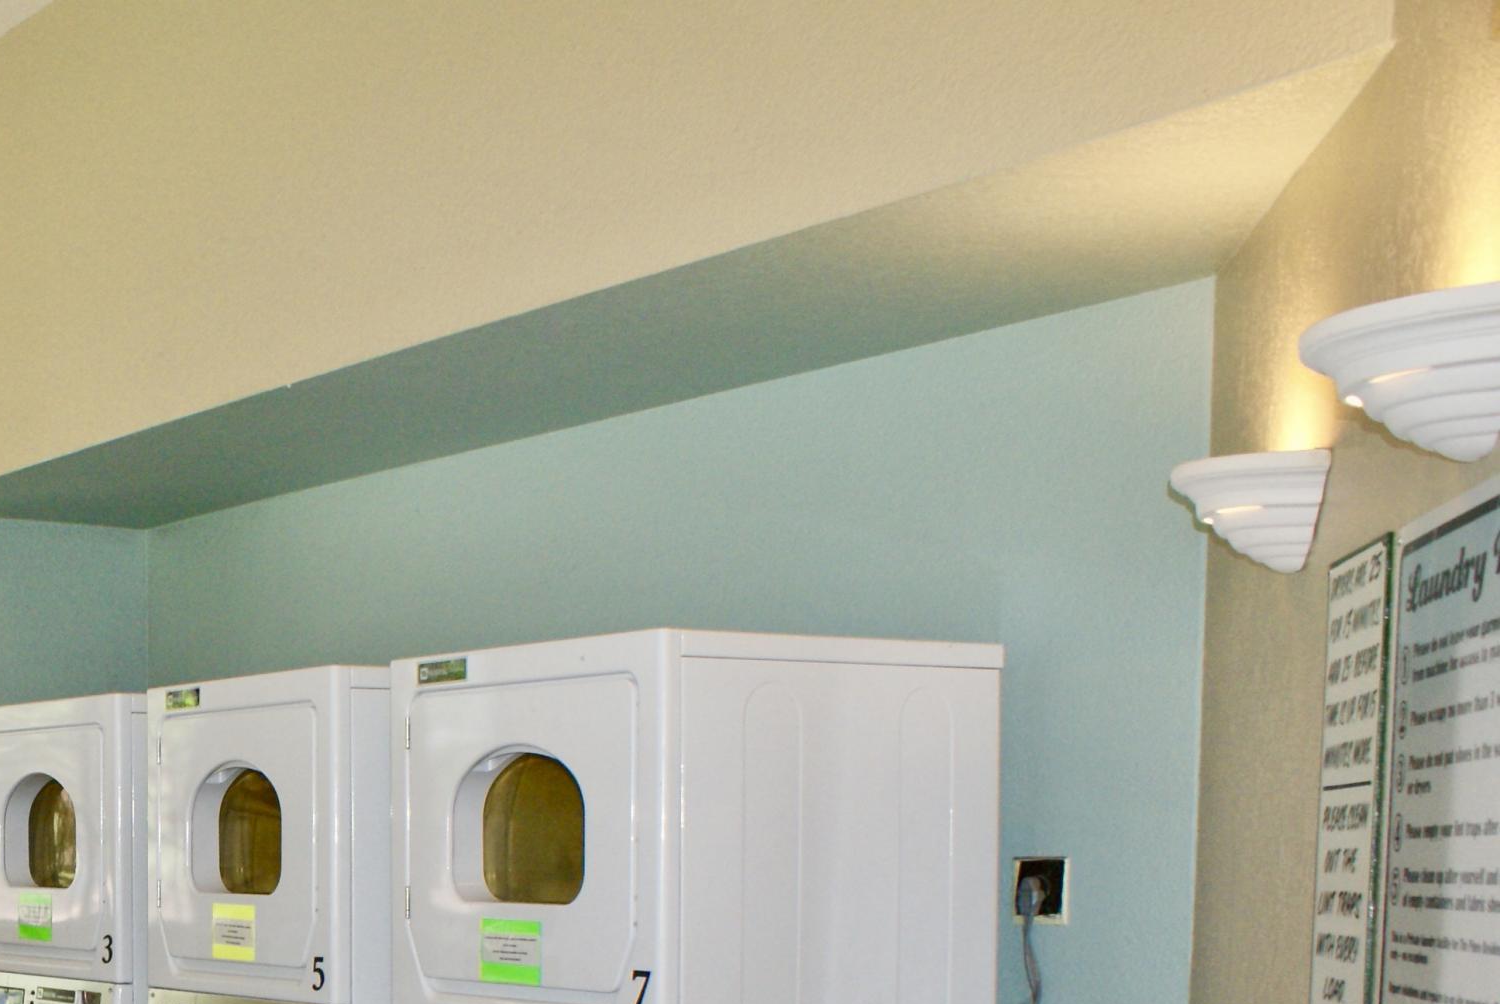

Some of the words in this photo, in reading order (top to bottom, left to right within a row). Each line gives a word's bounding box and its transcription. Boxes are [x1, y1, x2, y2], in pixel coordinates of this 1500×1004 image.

[1405, 546, 1488, 613] Laundry
[101, 934, 114, 965] 3
[311, 956, 326, 992] 5
